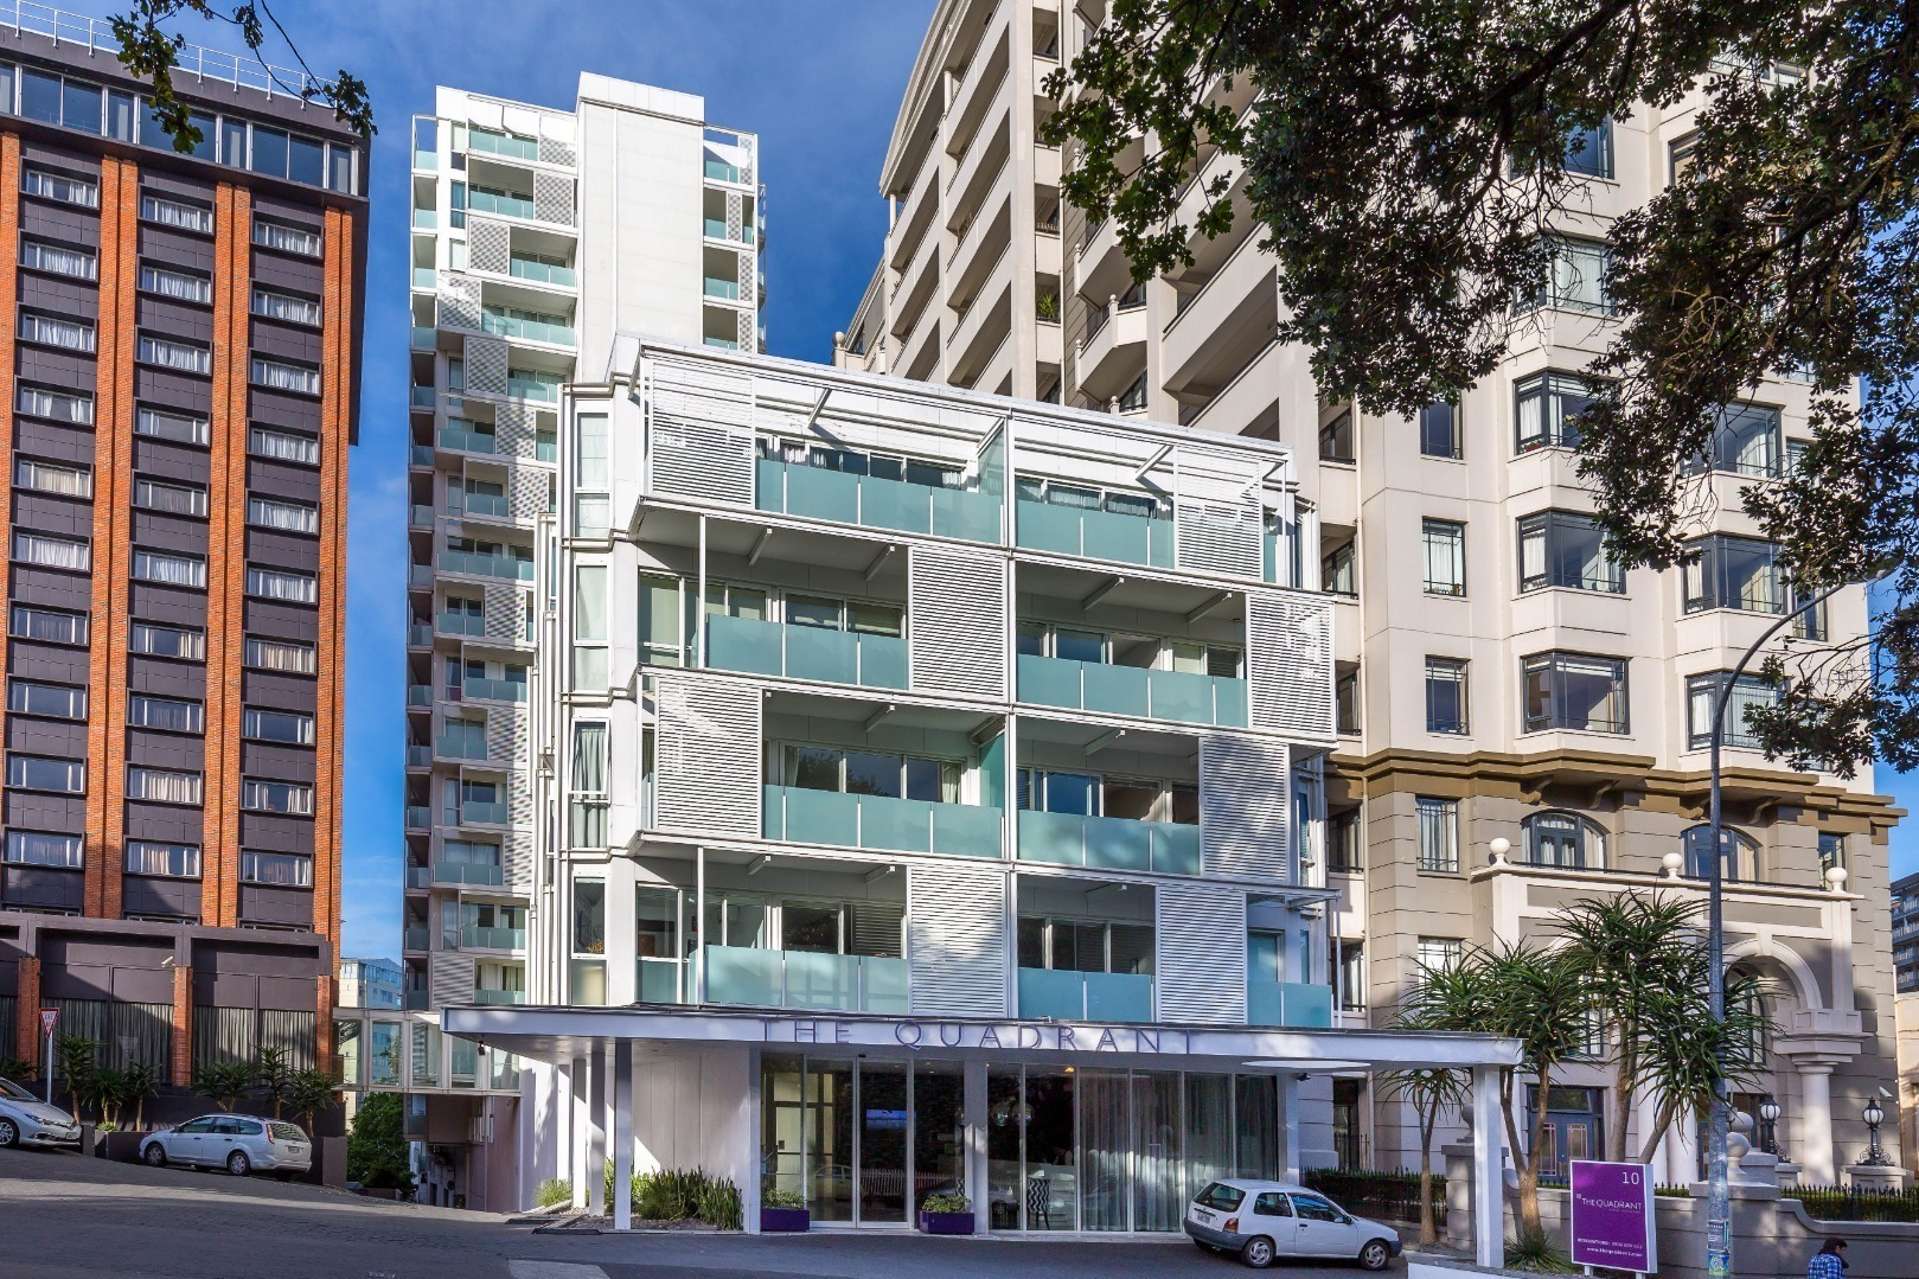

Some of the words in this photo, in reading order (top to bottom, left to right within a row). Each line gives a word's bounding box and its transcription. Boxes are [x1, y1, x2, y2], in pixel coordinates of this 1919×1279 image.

[758, 1018, 852, 1045] THE
[894, 1020, 1196, 1056] QUADRANT
[1621, 1171, 1640, 1185] 10
[1582, 1198, 1595, 1207] THE
[1596, 1199, 1642, 1210] QUADRANT
